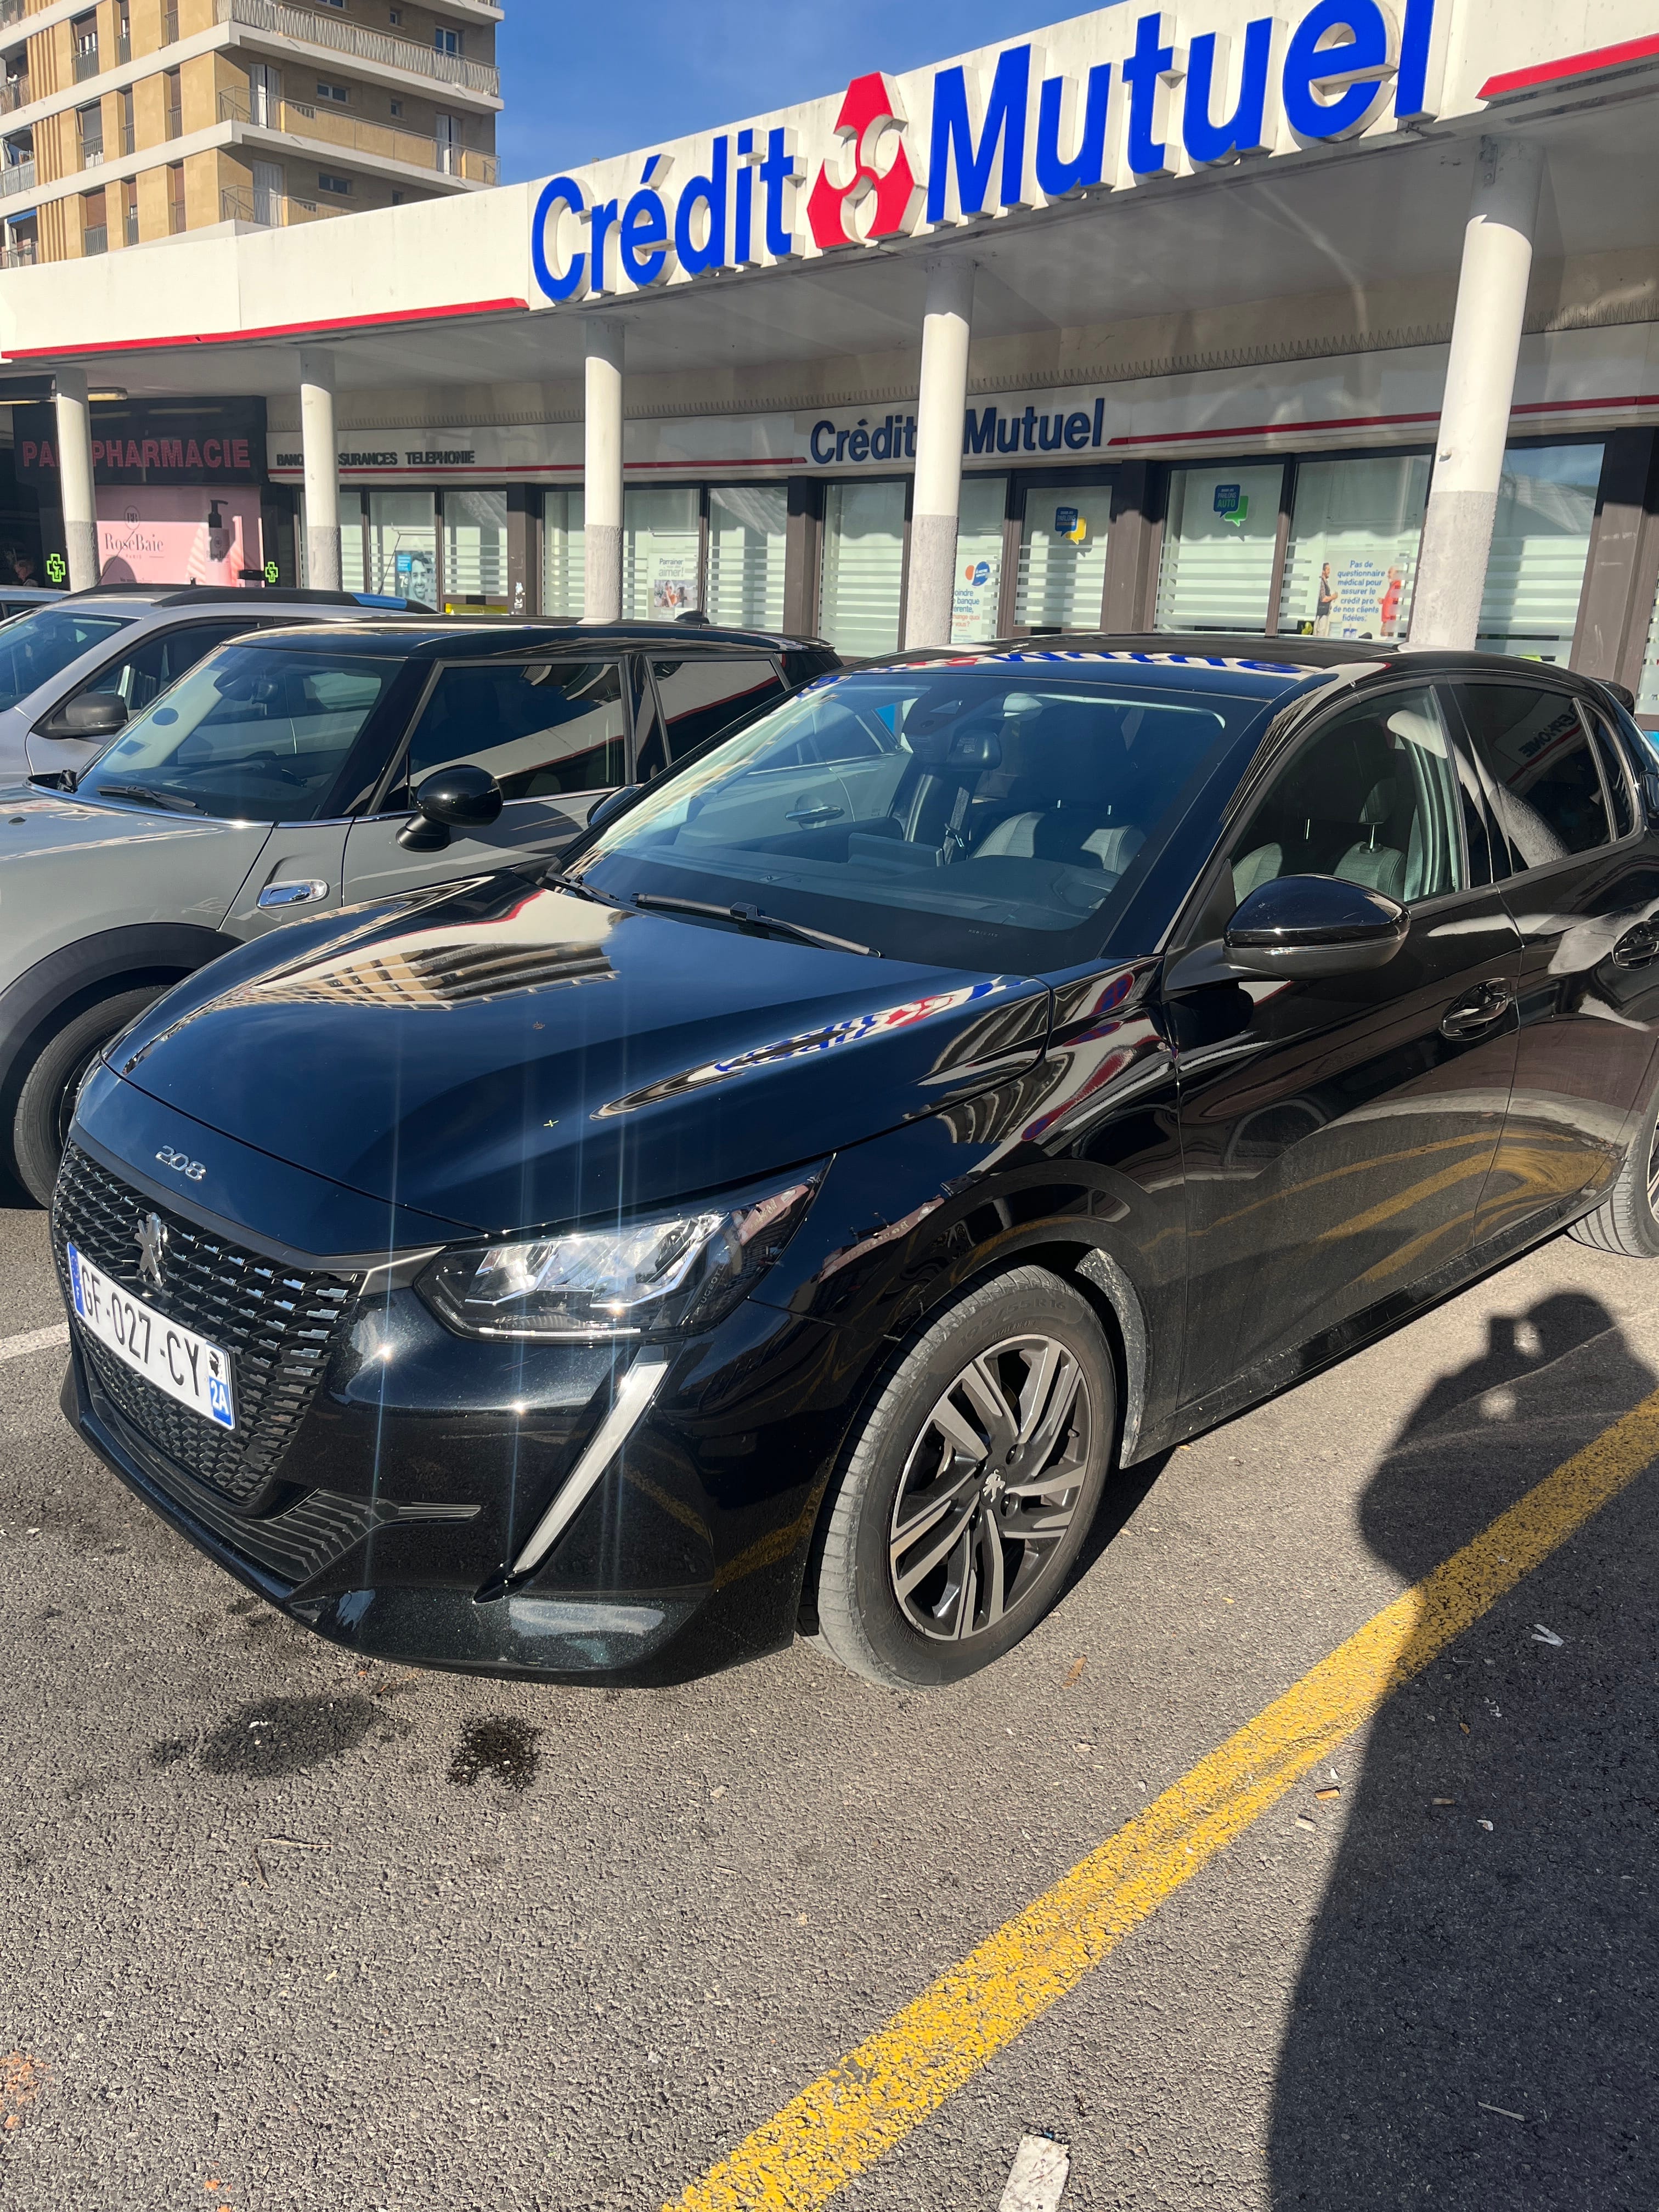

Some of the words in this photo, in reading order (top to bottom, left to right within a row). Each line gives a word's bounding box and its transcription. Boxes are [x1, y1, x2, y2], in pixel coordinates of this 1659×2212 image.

[532, 127, 794, 300] Crédit
[926, 0, 1434, 224] Mutuel
[810, 415, 917, 464] Crédit
[963, 398, 1104, 454] Mutuel
[22, 439, 251, 467] PAPHARMACIE
[338, 452, 397, 466] SURANCES
[405, 451, 475, 465] TELEPHONIE
[1217, 499, 1235, 508] AUTO
[957, 597, 980, 606] banque
[156, 1145, 207, 1181] 208
[211, 1380, 229, 1415] 2A
